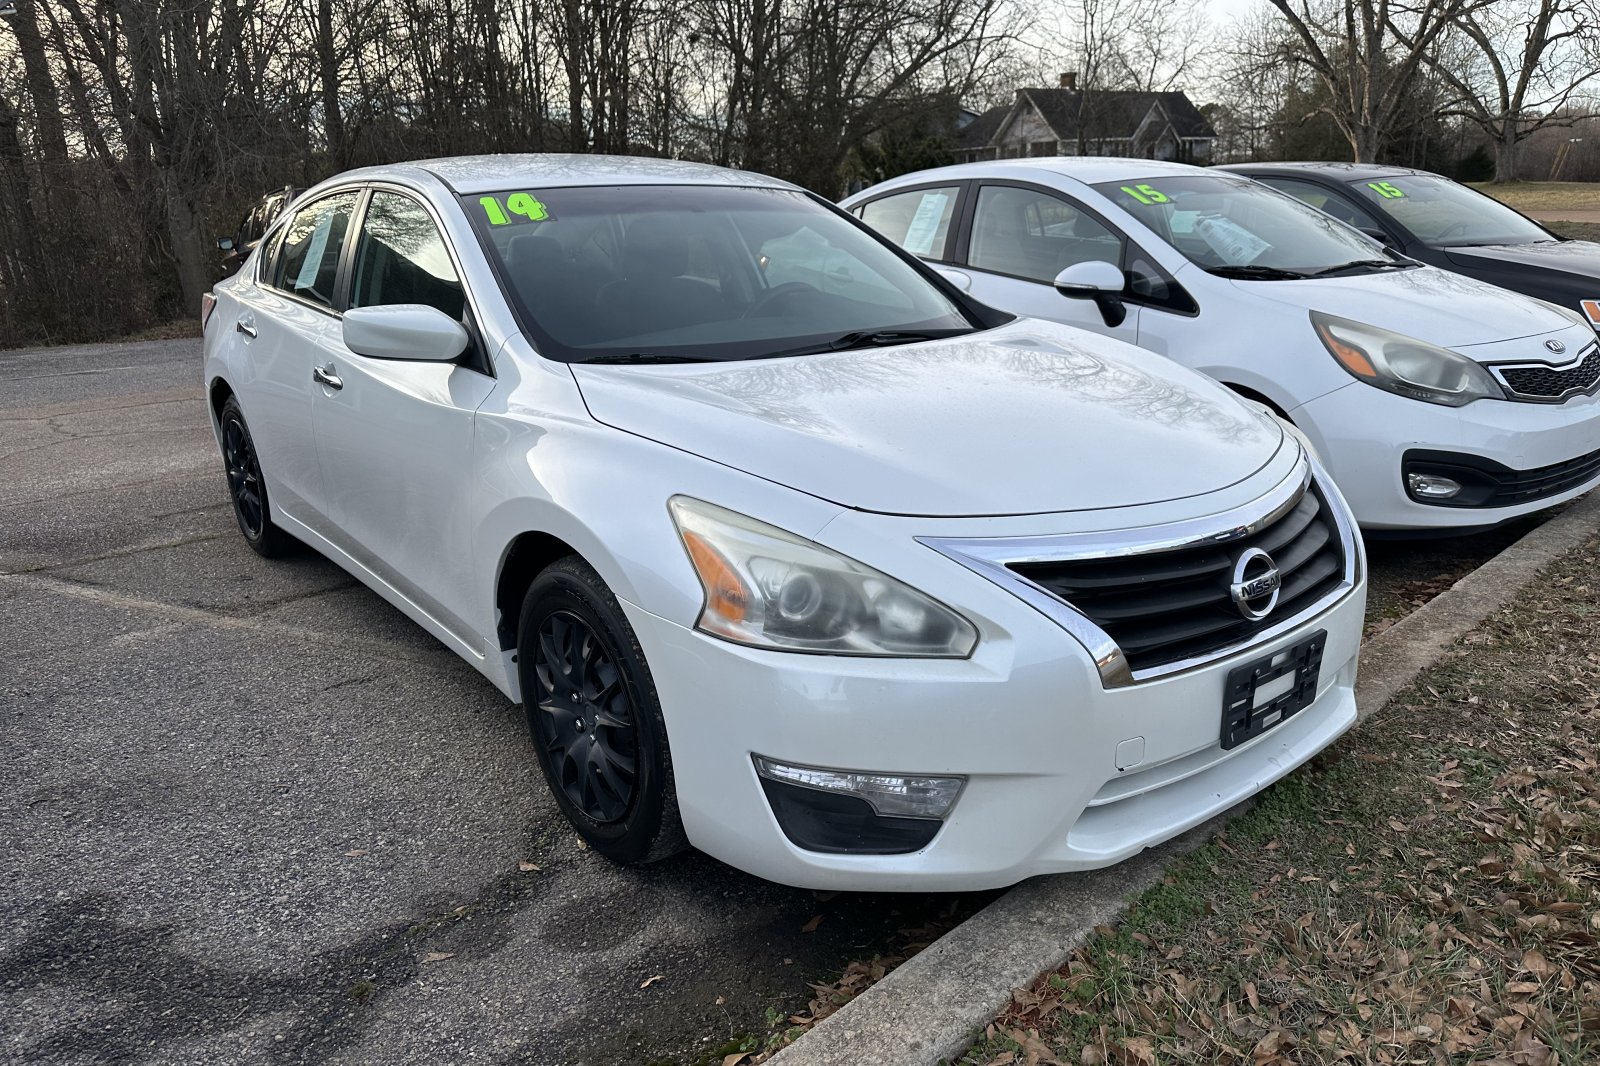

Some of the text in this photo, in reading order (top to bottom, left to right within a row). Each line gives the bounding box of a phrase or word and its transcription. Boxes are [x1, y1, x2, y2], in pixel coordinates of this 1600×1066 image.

[1121, 184, 1169, 204] 15
[1367, 182, 1404, 199] 15
[480, 193, 549, 225] 14
[1241, 575, 1280, 598] NISSAN
